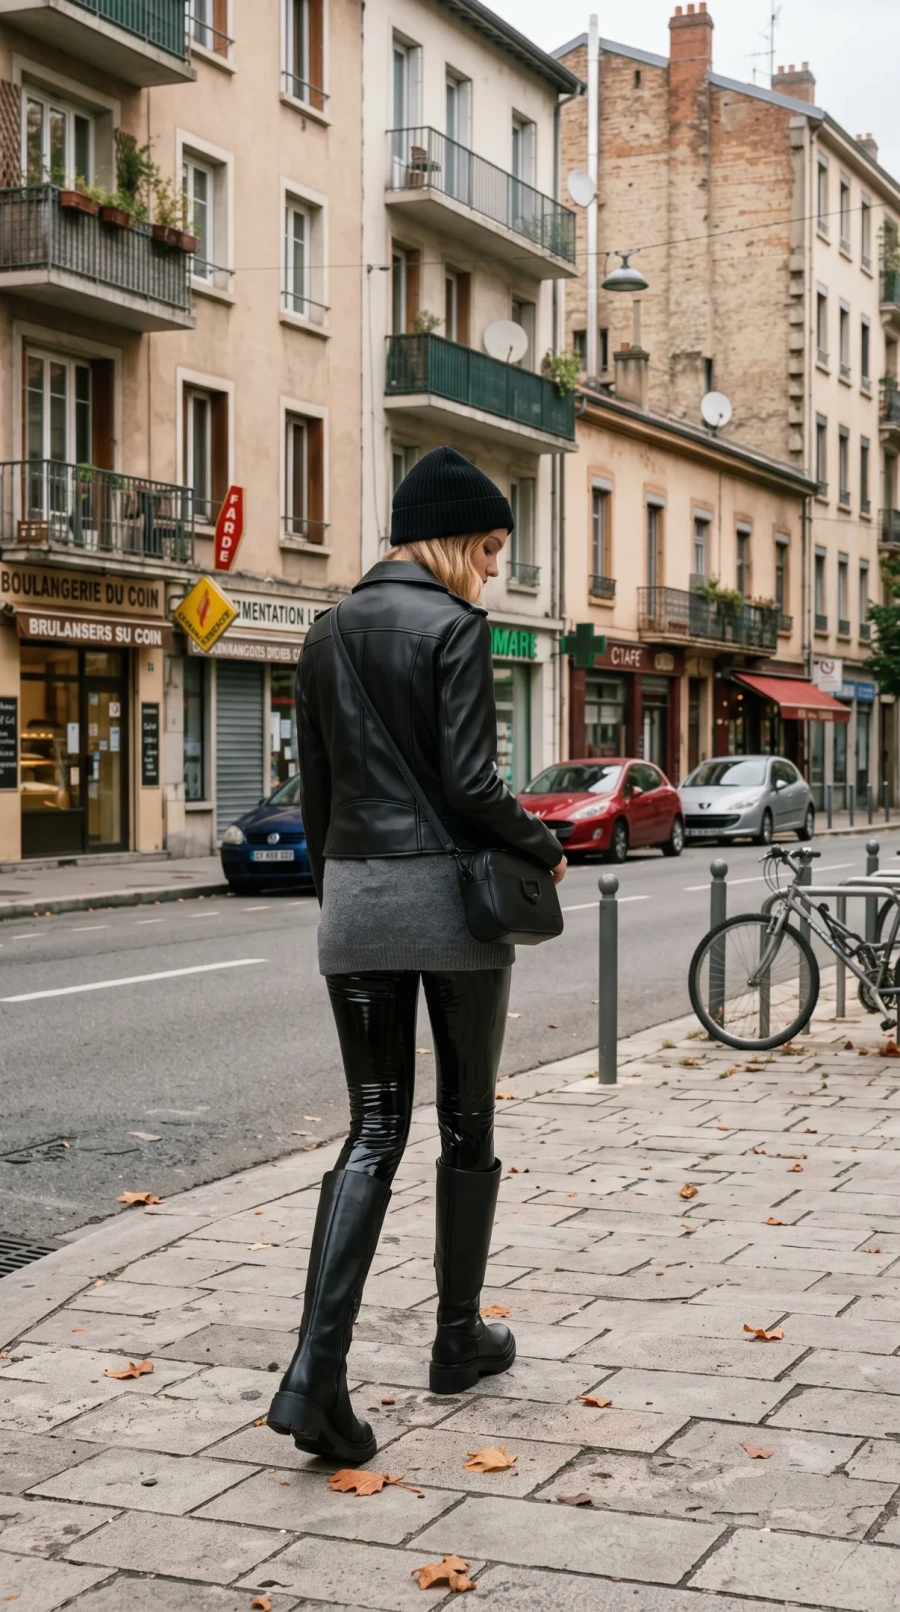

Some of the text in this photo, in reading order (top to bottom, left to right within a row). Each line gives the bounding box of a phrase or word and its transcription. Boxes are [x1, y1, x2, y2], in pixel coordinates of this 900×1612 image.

[219, 494, 239, 562] FARDE
[1, 571, 159, 608] BOULANGERIE DU COIN
[29, 618, 162, 645] BRULANSERS SU COIN
